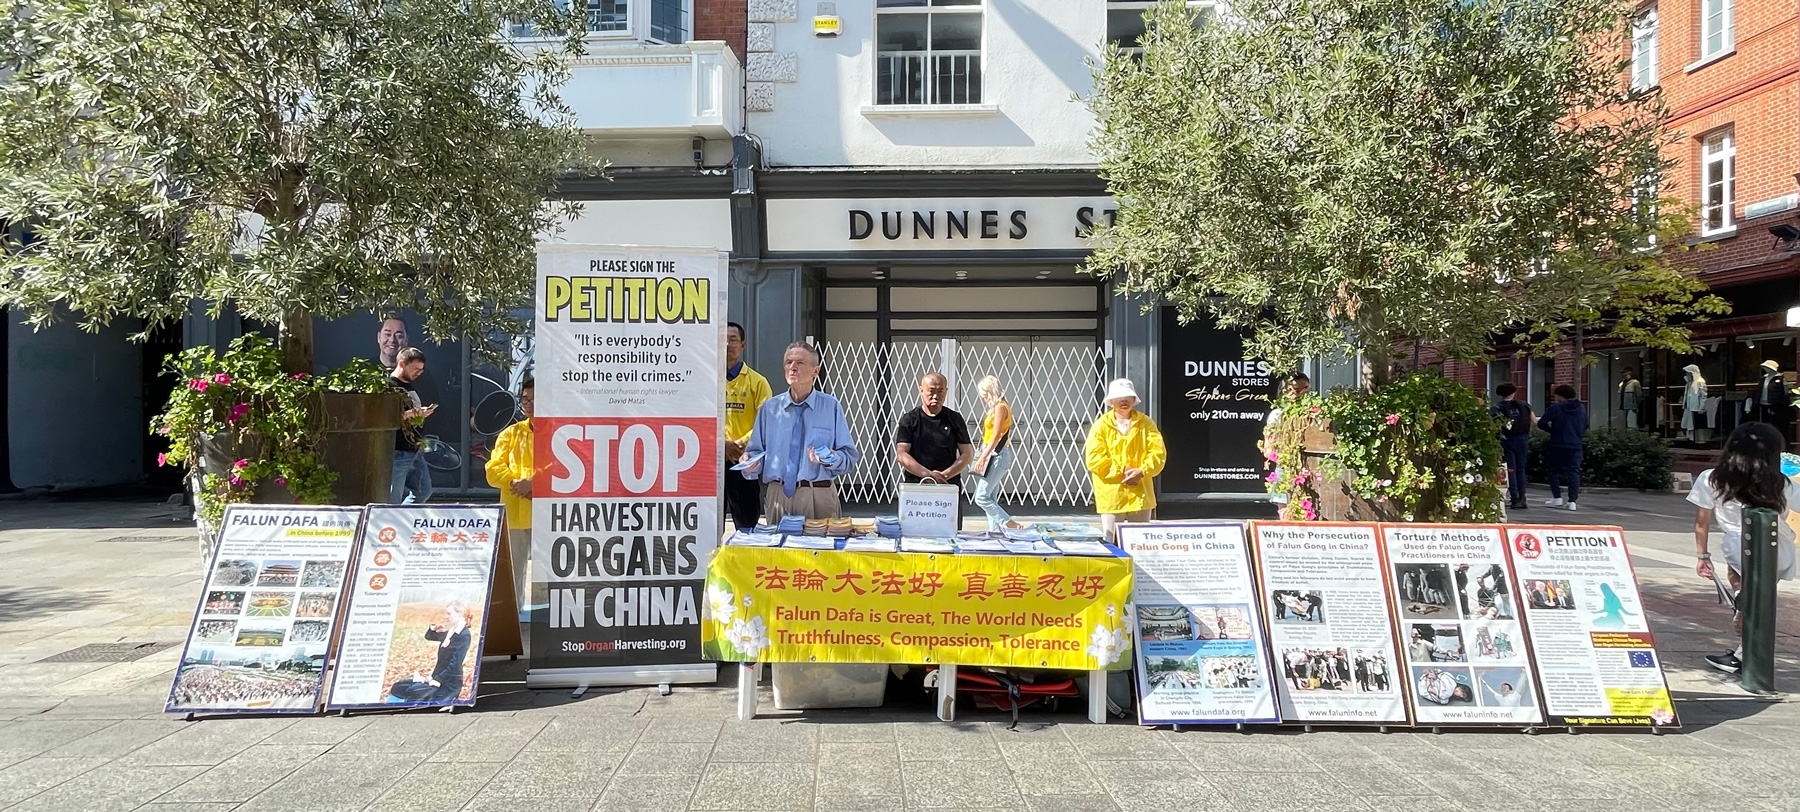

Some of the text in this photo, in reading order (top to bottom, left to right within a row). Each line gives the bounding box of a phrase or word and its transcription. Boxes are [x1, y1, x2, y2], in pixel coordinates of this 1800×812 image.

[849, 209, 1028, 240] DUNNES
[590, 260, 675, 273] PLEASE SIGN THE
[545, 276, 710, 324] PETITION
[593, 334, 603, 346] is
[607, 334, 681, 348] everybody's
[578, 352, 677, 365] responsibility to
[1184, 361, 1270, 377] DUNNES
[562, 370, 589, 383] stop
[592, 370, 612, 382] the
[616, 370, 638, 382] evil
[1232, 378, 1269, 386] STORES
[640, 388, 657, 396] rights
[1190, 410, 1264, 421] only 210m away
[551, 424, 700, 493] STOP
[232, 515, 318, 526] FALUN DAFA
[413, 519, 491, 528] FALUN DAFA
[551, 502, 698, 532] HARVESTING
[410, 532, 489, 543] 法輪大法
[1166, 532, 1202, 541] Spread
[1262, 531, 1284, 540] Why
[1394, 533, 1490, 542] Torture Methods
[1546, 536, 1608, 547] PETITION
[1162, 543, 1189, 551] Gong
[551, 535, 698, 577] ORGANS
[755, 566, 944, 597] 法輪大法好
[957, 572, 1105, 601] 真善忍好
[549, 586, 698, 628] IN CHINA
[775, 606, 1083, 628] Falun Dafa is Great, The World Needs
[562, 638, 686, 652] StopOrganHarvesting.org
[777, 629, 1080, 651] Truthfulness, Compassion, Tolerance
[1171, 709, 1245, 717] www.falundafa.org
[1443, 711, 1513, 719] www.faluninfo.net
